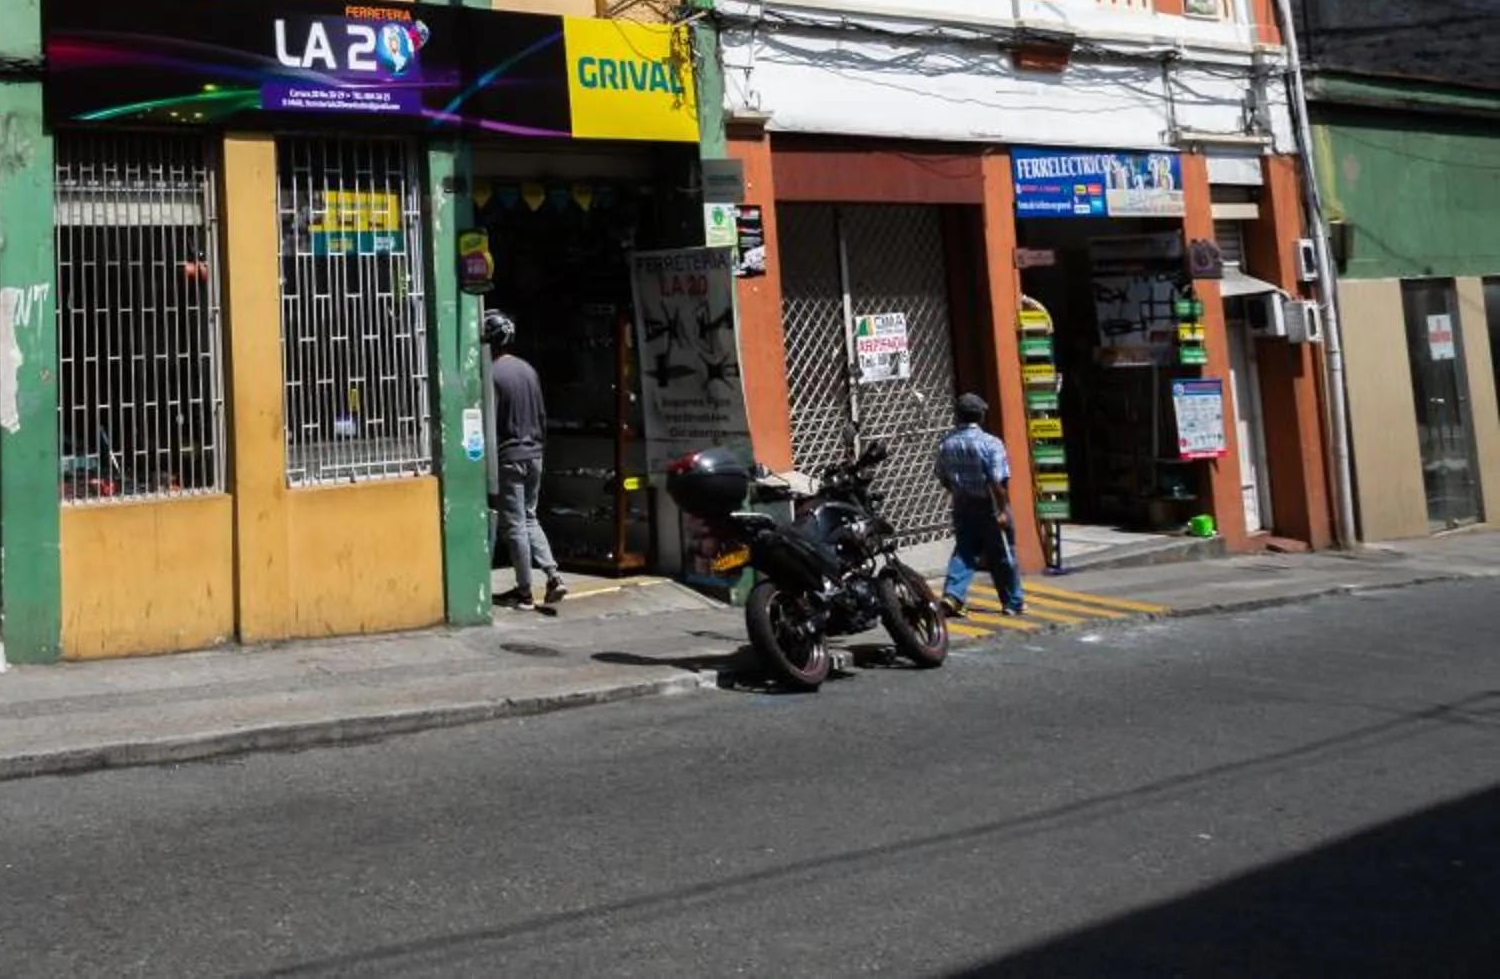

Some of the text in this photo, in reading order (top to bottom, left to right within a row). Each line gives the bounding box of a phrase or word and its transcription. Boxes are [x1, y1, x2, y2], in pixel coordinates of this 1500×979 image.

[345, 4, 412, 21] FERRETERIA
[275, 19, 337, 70] LA
[577, 56, 685, 95] GRIVAL
[1016, 153, 1118, 180] FERRELECTRICOS
